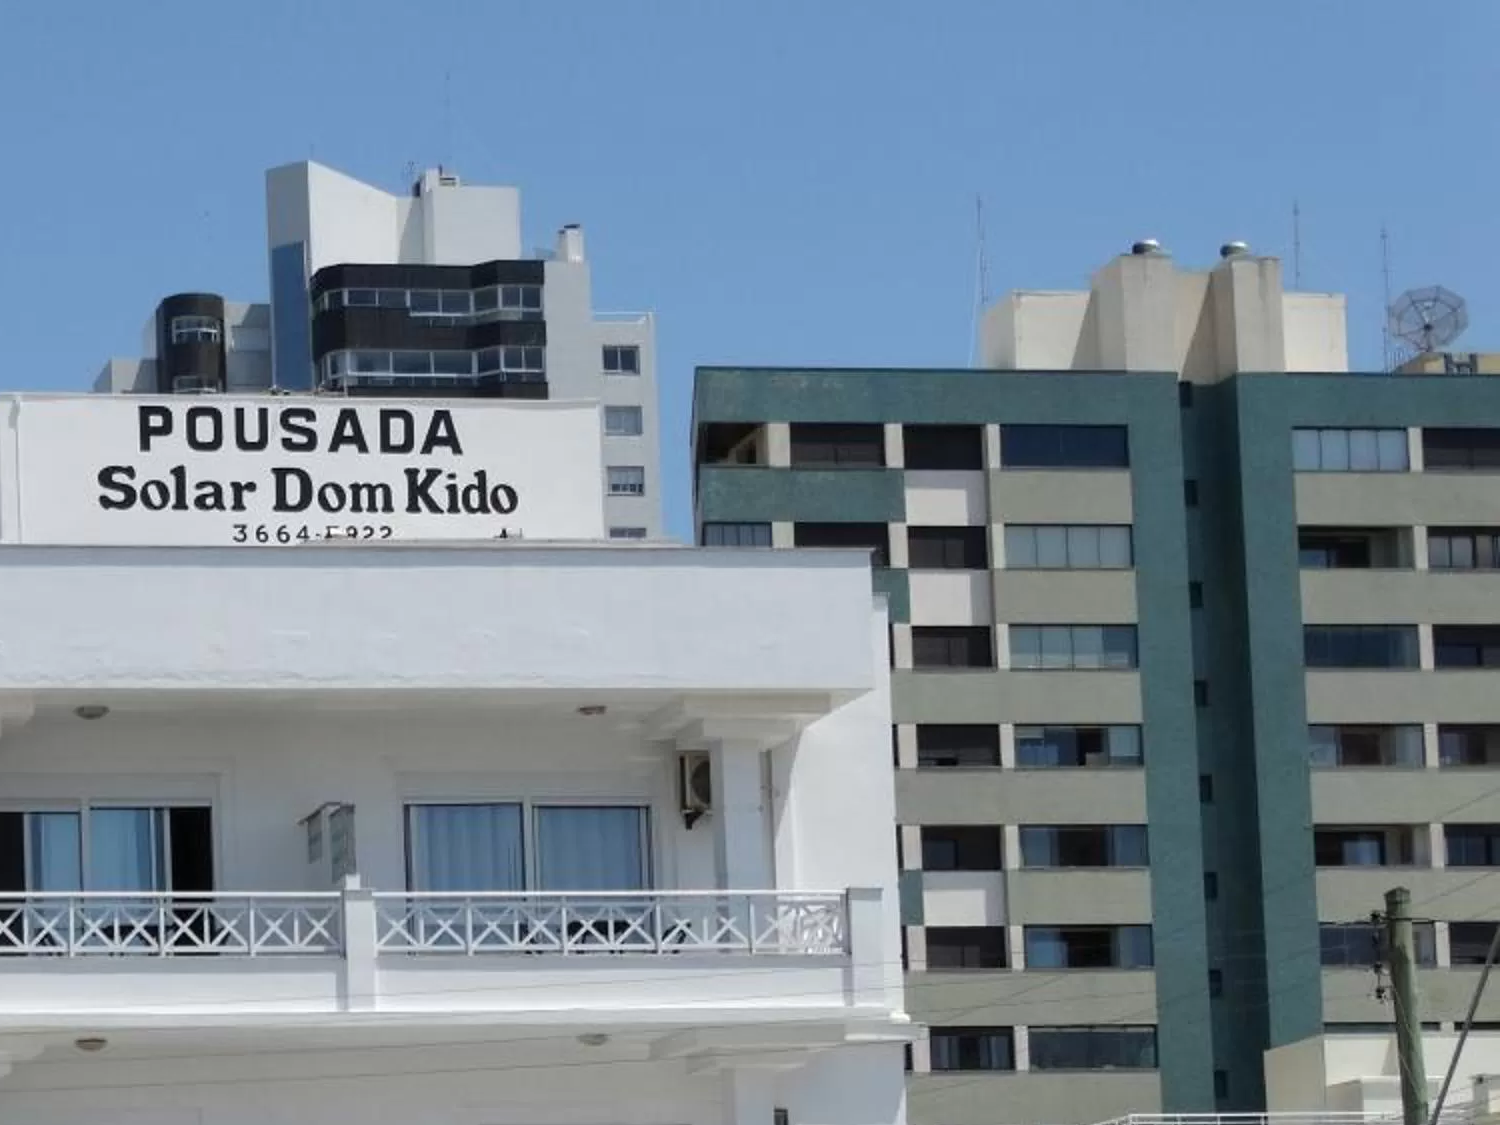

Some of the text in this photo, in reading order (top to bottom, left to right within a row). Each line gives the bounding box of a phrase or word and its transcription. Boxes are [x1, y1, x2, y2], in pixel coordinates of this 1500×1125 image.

[137, 405, 463, 456] POUSADA
[97, 464, 519, 515] Solar Dom Kido
